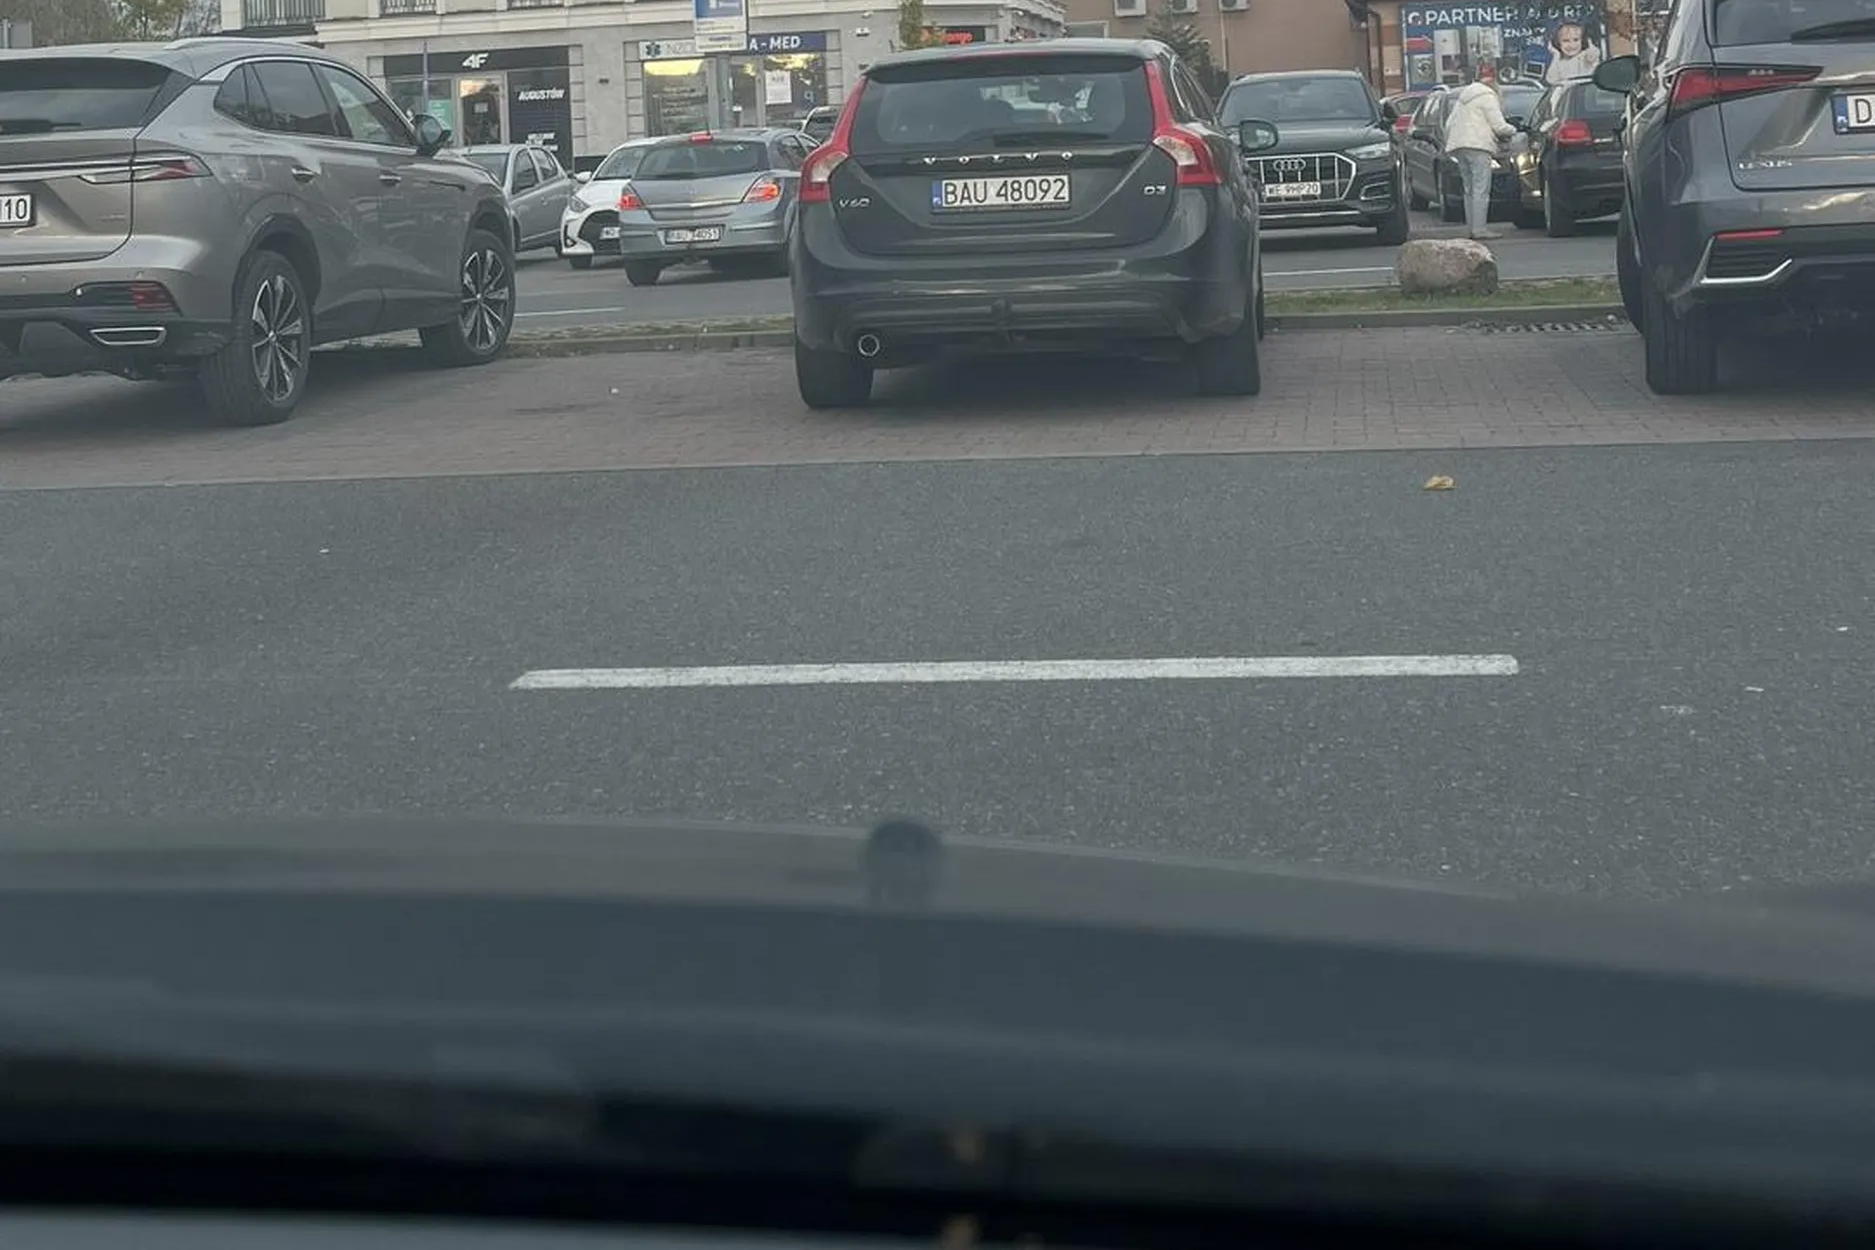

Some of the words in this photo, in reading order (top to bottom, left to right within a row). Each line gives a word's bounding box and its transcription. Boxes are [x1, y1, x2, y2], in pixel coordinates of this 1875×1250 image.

[769, 35, 801, 49] MED
[462, 52, 489, 69] 4F
[518, 87, 565, 101] AUGUSTÓW
[923, 151, 1074, 164] VOLVO
[943, 182, 987, 205] BAU
[995, 178, 1067, 203] 48092
[0, 197, 28, 221] 10
